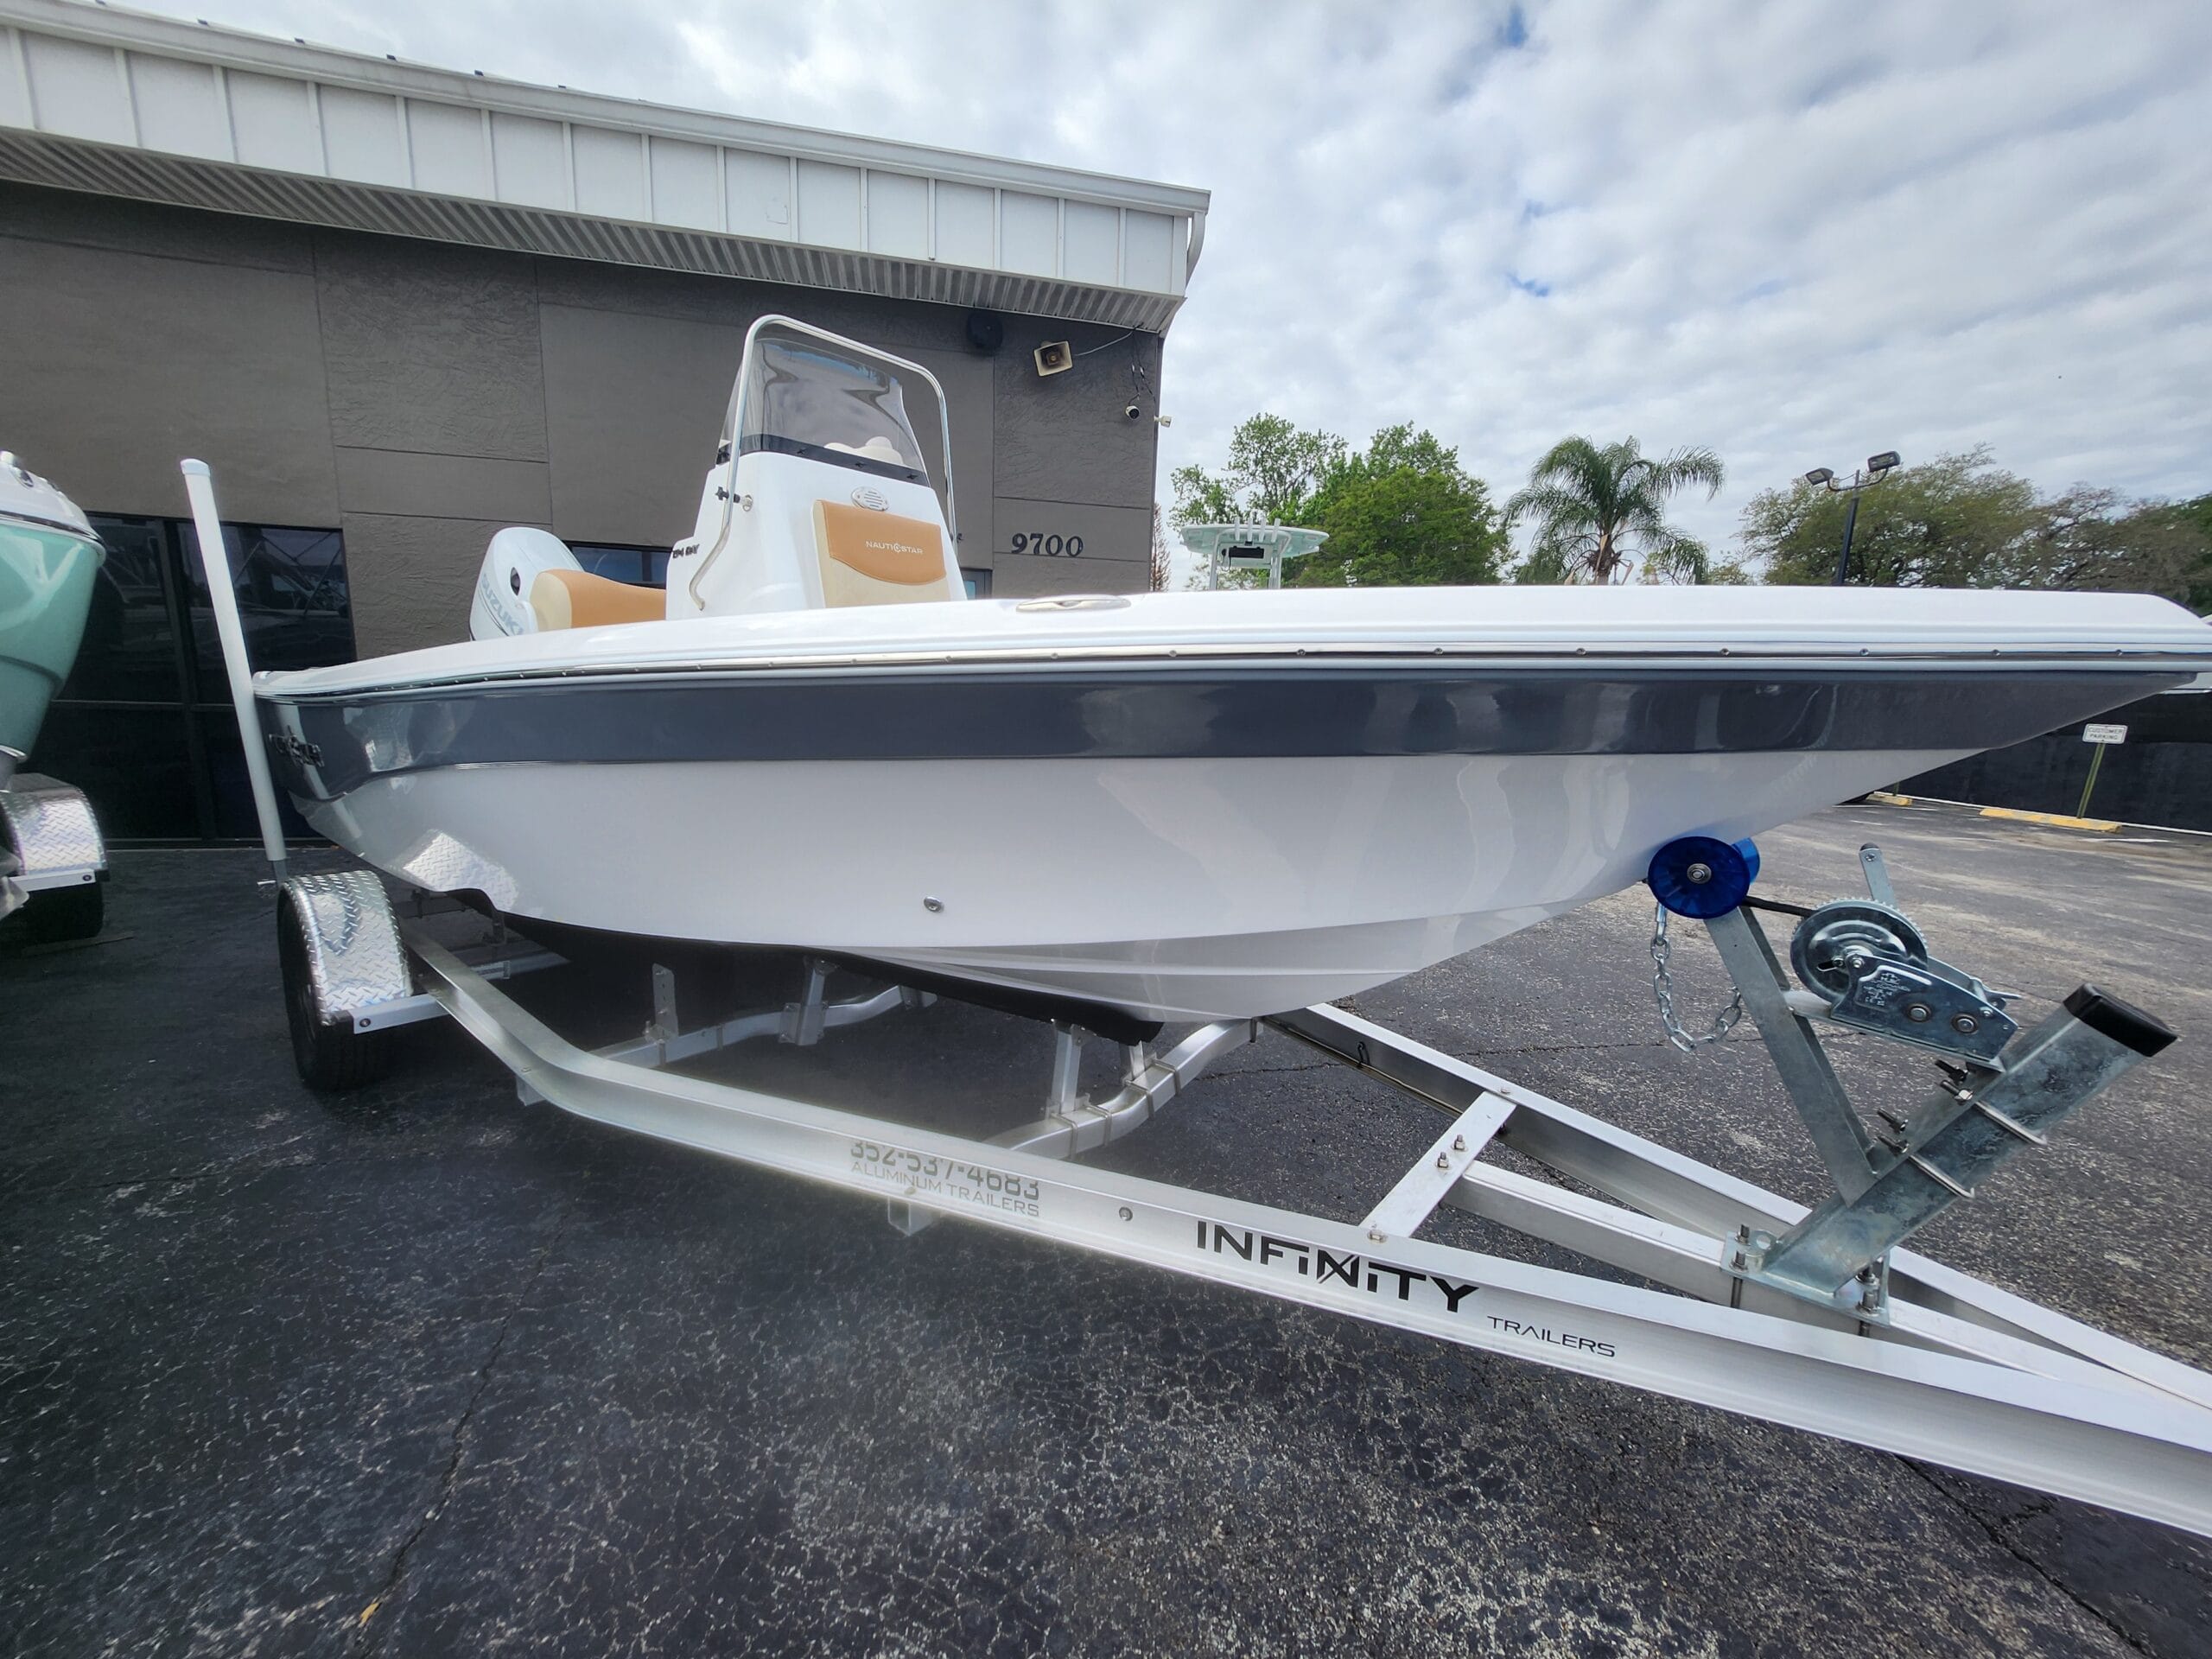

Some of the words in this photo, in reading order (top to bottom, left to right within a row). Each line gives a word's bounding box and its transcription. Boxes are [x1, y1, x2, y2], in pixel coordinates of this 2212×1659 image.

[1011, 533, 1084, 557] 9700
[480, 574, 524, 636] SUZUKI
[851, 1161, 942, 1193] ALUMINUM
[946, 1182, 1040, 1217] TRAILERS
[1197, 1219, 1479, 1313] INFINITY
[1487, 1315, 1616, 1357] TRAILERS
